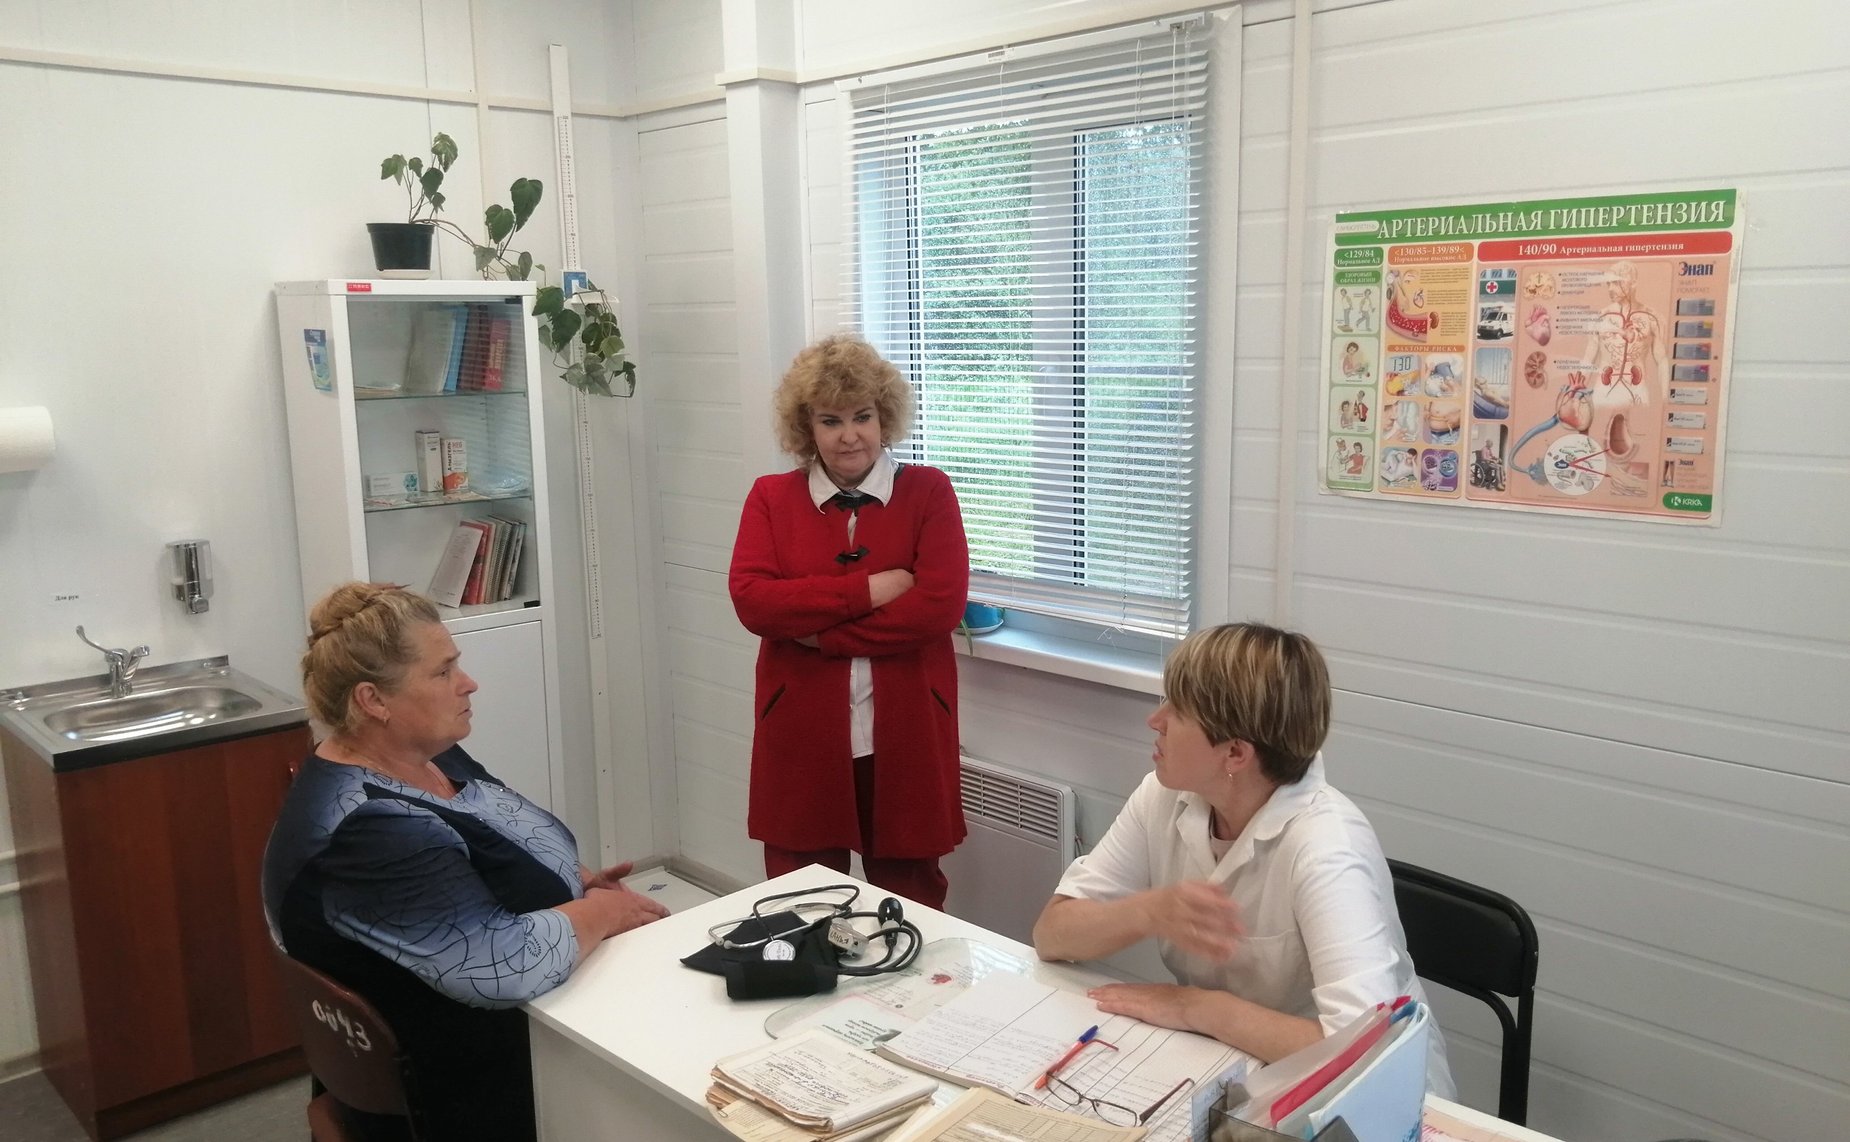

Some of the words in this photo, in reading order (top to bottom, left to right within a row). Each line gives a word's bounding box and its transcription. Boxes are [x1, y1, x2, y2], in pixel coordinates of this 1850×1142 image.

[1377, 209, 1543, 239] АРТЕРИАЛЬНАЯ
[1548, 200, 1726, 230] ГИПЕРТЕНЗИЯ
[1344, 249, 1375, 259] <129/84
[1518, 244, 1557, 256] 140/90
[1560, 245, 1623, 256] Артериальная
[1625, 243, 1684, 253] гипертензия
